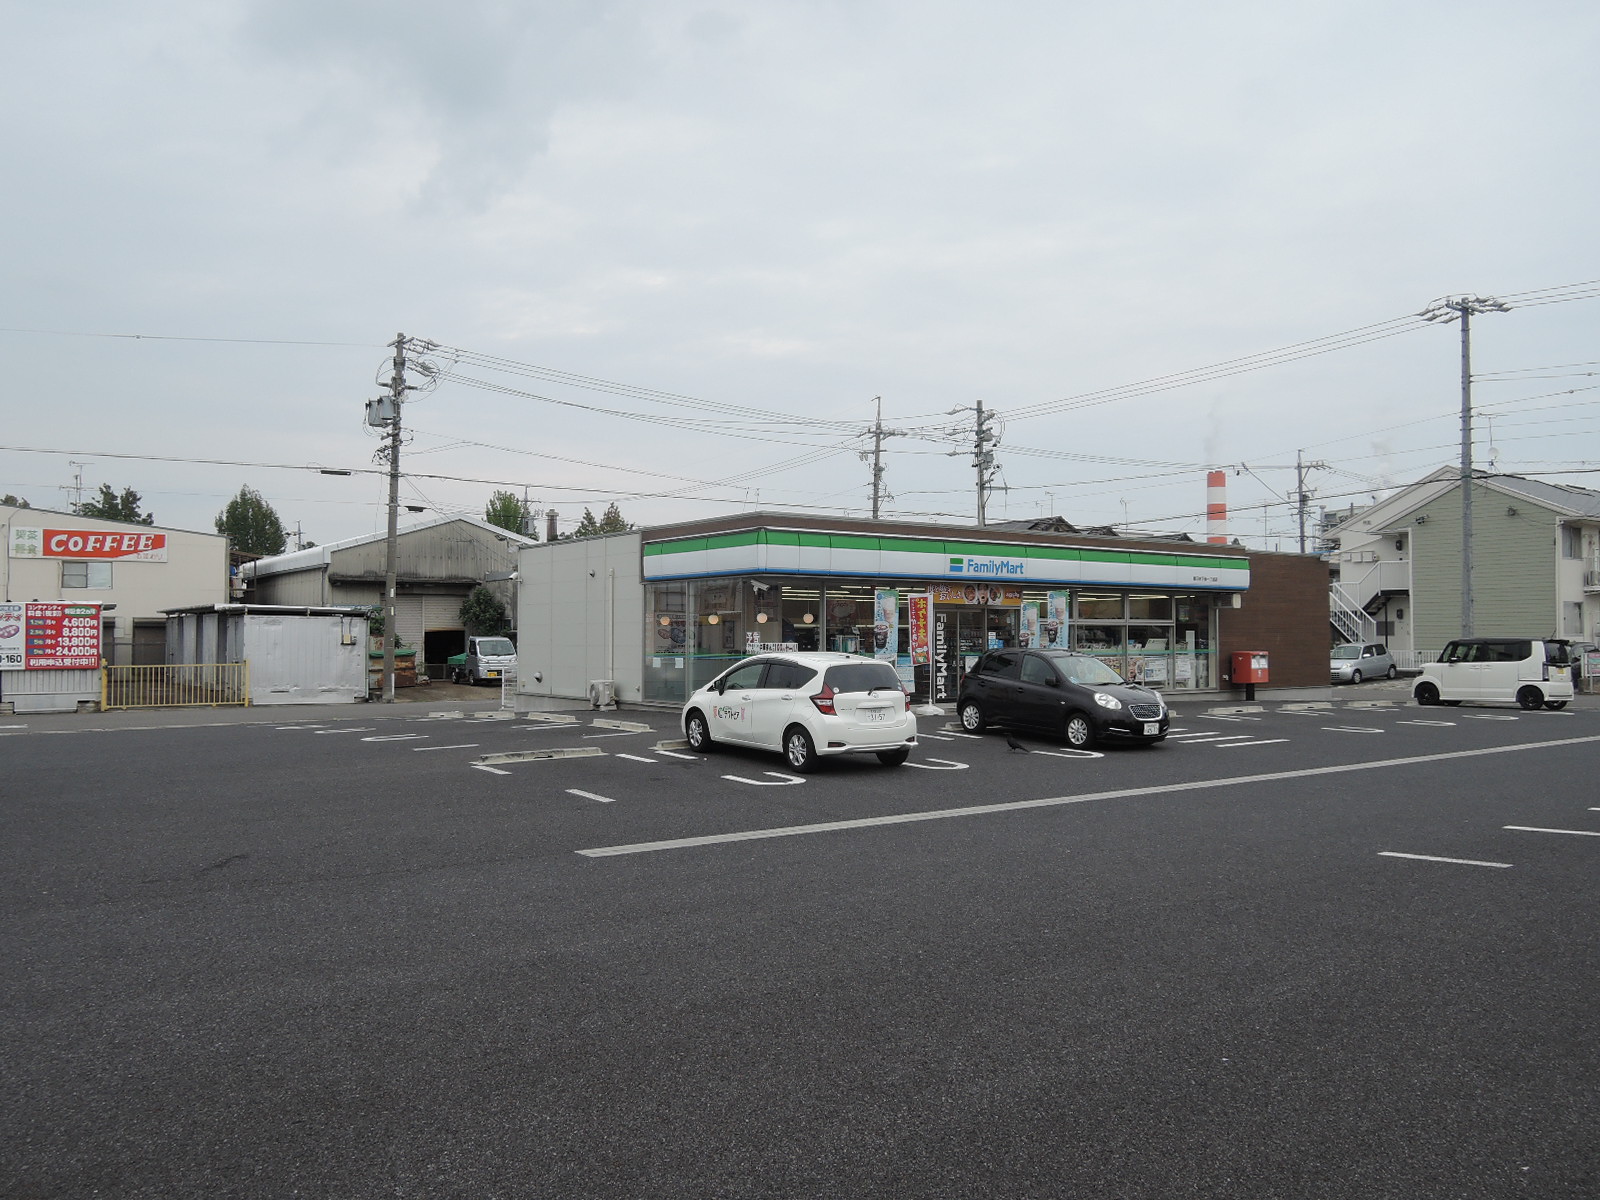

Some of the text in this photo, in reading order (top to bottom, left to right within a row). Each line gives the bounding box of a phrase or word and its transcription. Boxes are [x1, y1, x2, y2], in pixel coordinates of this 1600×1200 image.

[15, 529, 38, 541] 喫茶
[50, 534, 155, 552] COFFEE
[967, 559, 1024, 575] FamilyMart
[935, 613, 948, 699] FamilyMart
